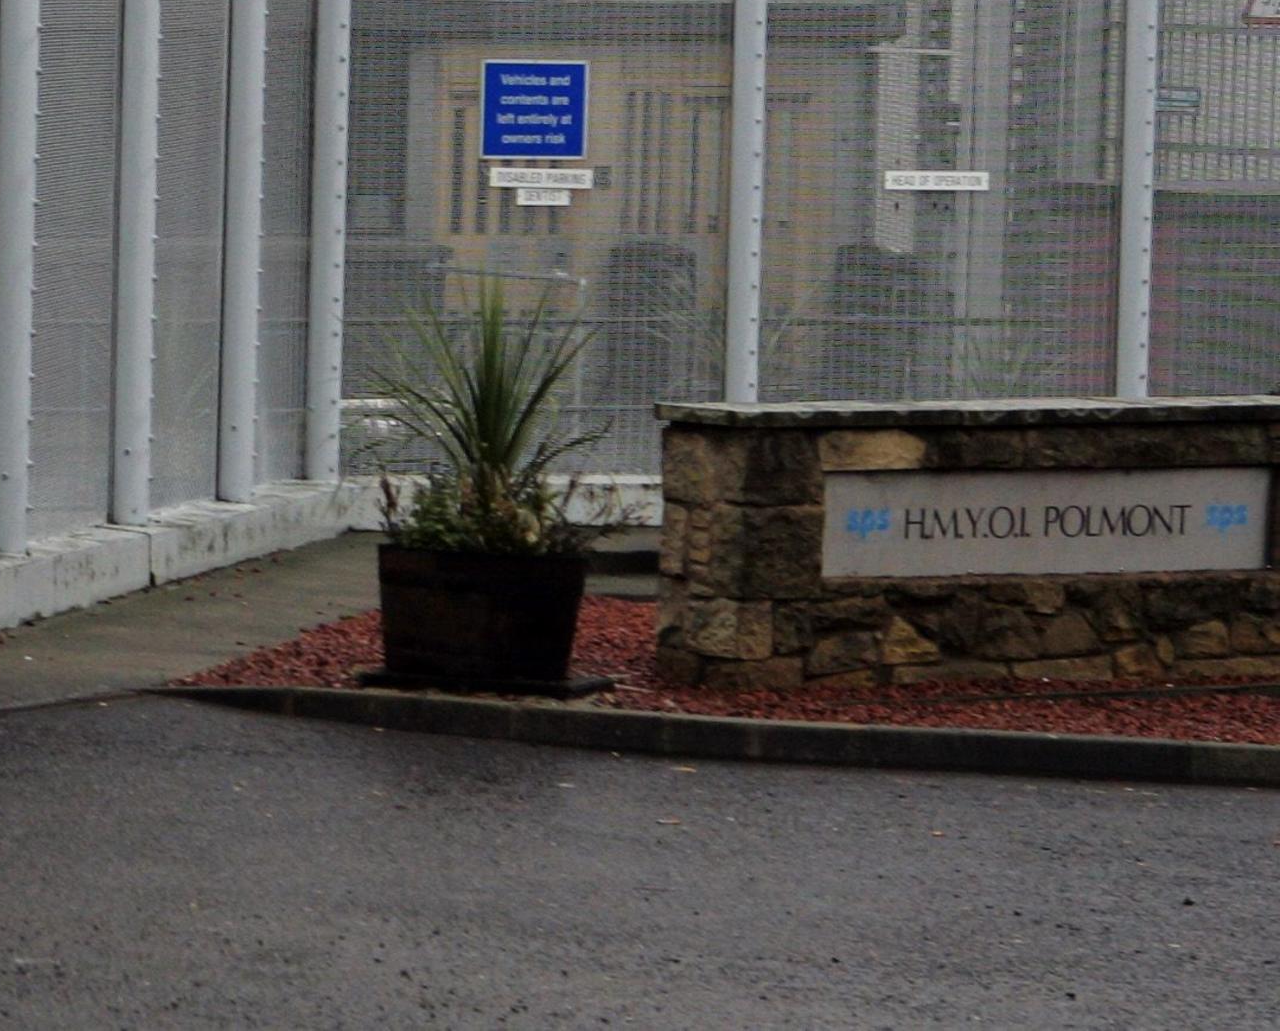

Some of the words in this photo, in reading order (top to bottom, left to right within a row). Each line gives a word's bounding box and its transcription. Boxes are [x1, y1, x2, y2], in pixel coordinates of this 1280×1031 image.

[500, 74, 547, 86] Vehicles
[549, 74, 571, 86] and
[500, 95, 550, 105] contents
[551, 96, 570, 105] are
[496, 113, 515, 125] left
[517, 113, 558, 128] entirely
[560, 114, 573, 125] at
[501, 135, 542, 144] owners
[544, 132, 567, 144] risk
[1043, 503, 1193, 538] POLMONT
